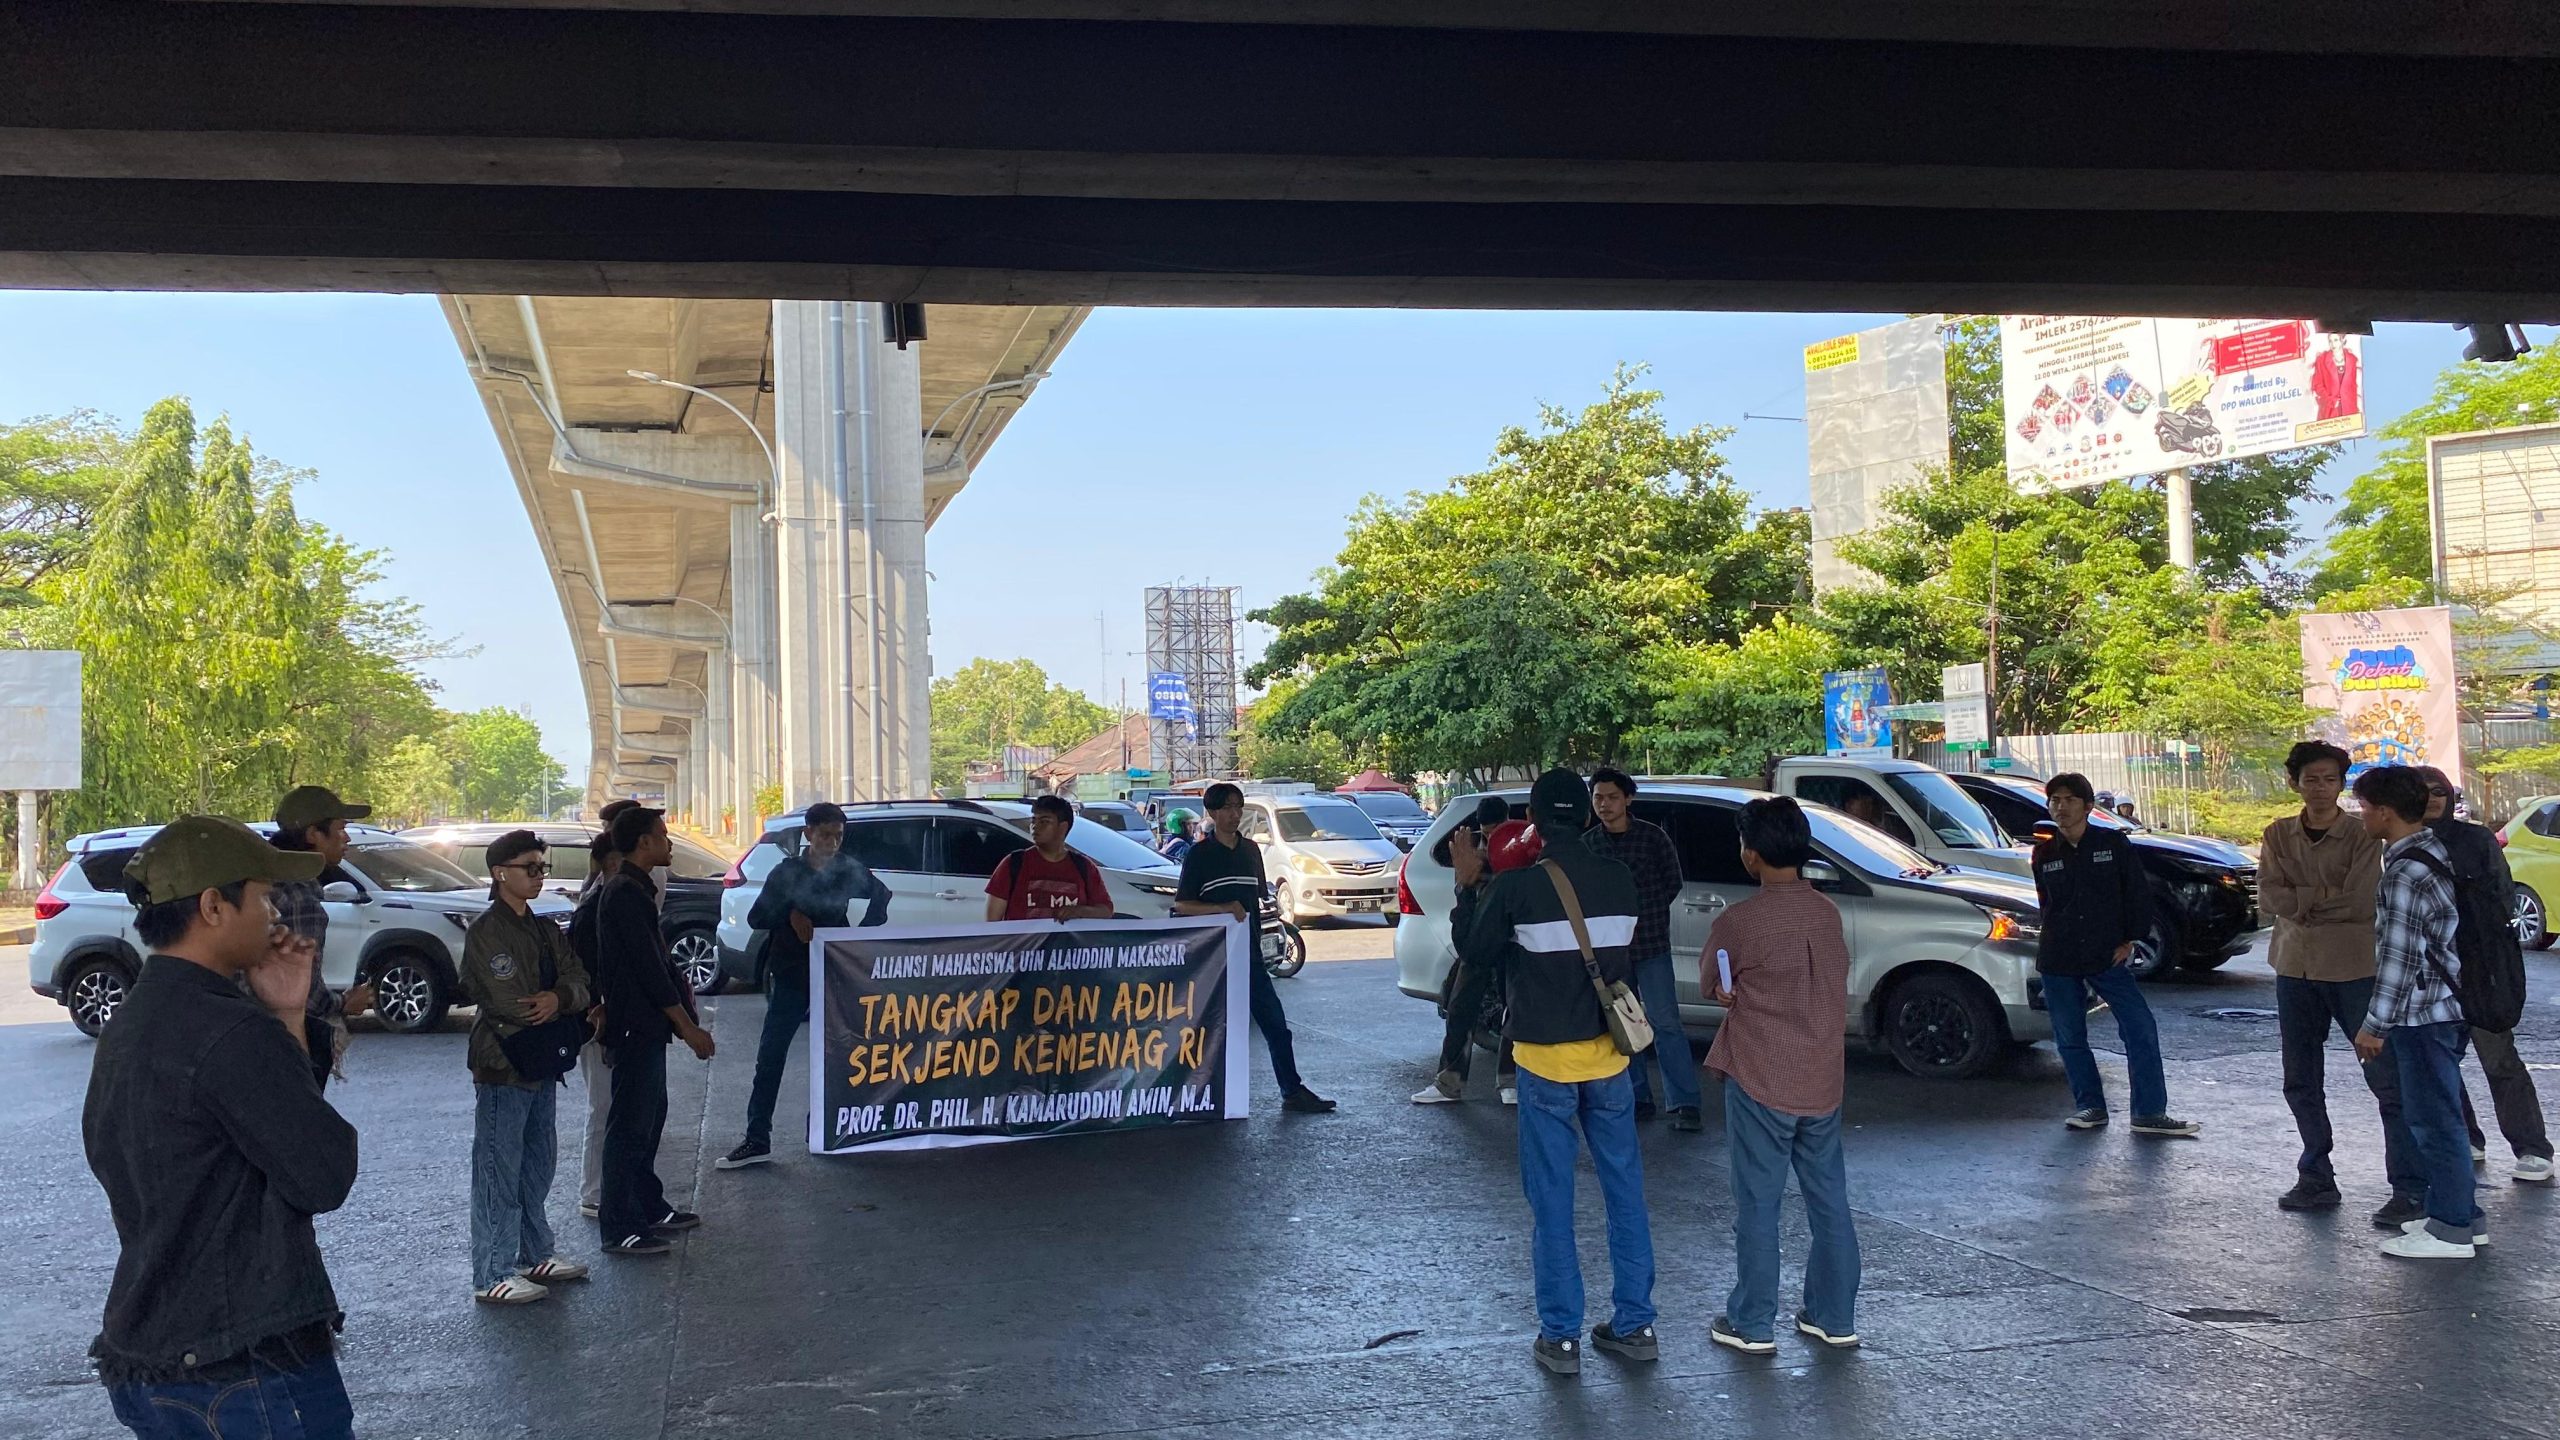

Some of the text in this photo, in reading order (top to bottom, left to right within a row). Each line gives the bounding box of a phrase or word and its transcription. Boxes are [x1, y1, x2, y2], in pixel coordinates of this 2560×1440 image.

[2035, 324, 2067, 341] IMLEK
[2094, 351, 2130, 366] SULAWESI
[2233, 378, 2273, 394] Presented
[2221, 387, 2302, 412] DPD WALUBI SULSEL
[2344, 645, 2416, 667] Jauh
[2348, 661, 2412, 679] Dekat
[871, 943, 1187, 979] ALIANSI MAHASISWA UIN ALAUDDIN MAKASSAR
[858, 980, 1195, 1040] TANGKAP DAN ADILI
[848, 1026, 1206, 1088] SEKJEND KEMENAG RI
[835, 1083, 1215, 1136] PROF. DR. PHIL. H. KAMARUDDIN AMIN, M.A.
